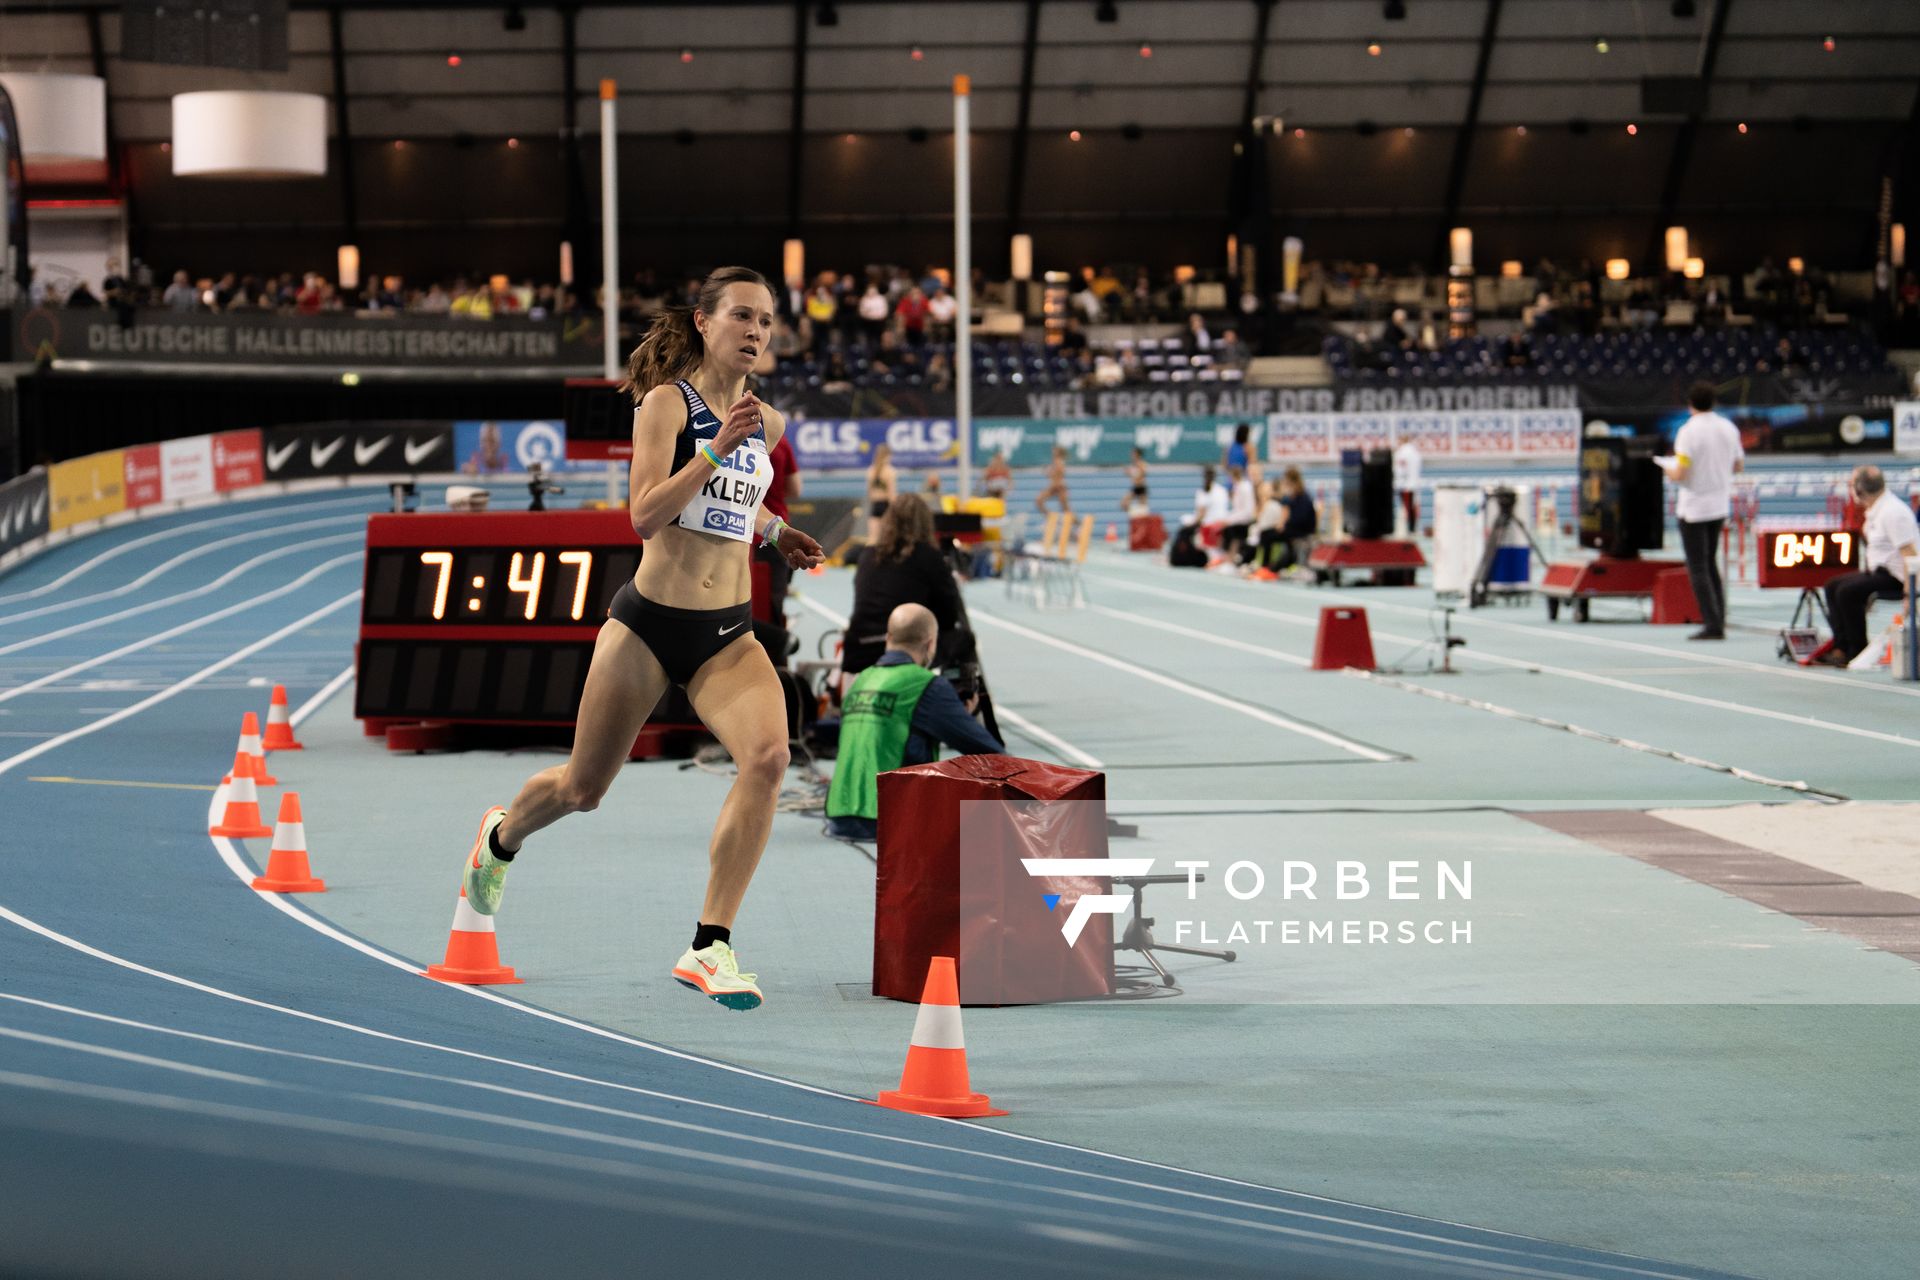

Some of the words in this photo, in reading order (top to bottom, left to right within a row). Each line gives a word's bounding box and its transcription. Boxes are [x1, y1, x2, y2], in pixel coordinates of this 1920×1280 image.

[88, 325, 228, 351] DEUTSCHE
[235, 327, 557, 357] HALLENMEISTERSCHAFTEN
[1027, 392, 1087, 419] VIEL
[1100, 390, 1209, 418] ERFOLG
[1216, 388, 1273, 416] AUF
[1278, 388, 1334, 413] DER
[702, 475, 761, 508] KLEIN
[727, 514, 745, 528] PLAN
[1773, 532, 1851, 567] 0:47
[420, 551, 592, 621] 7:47
